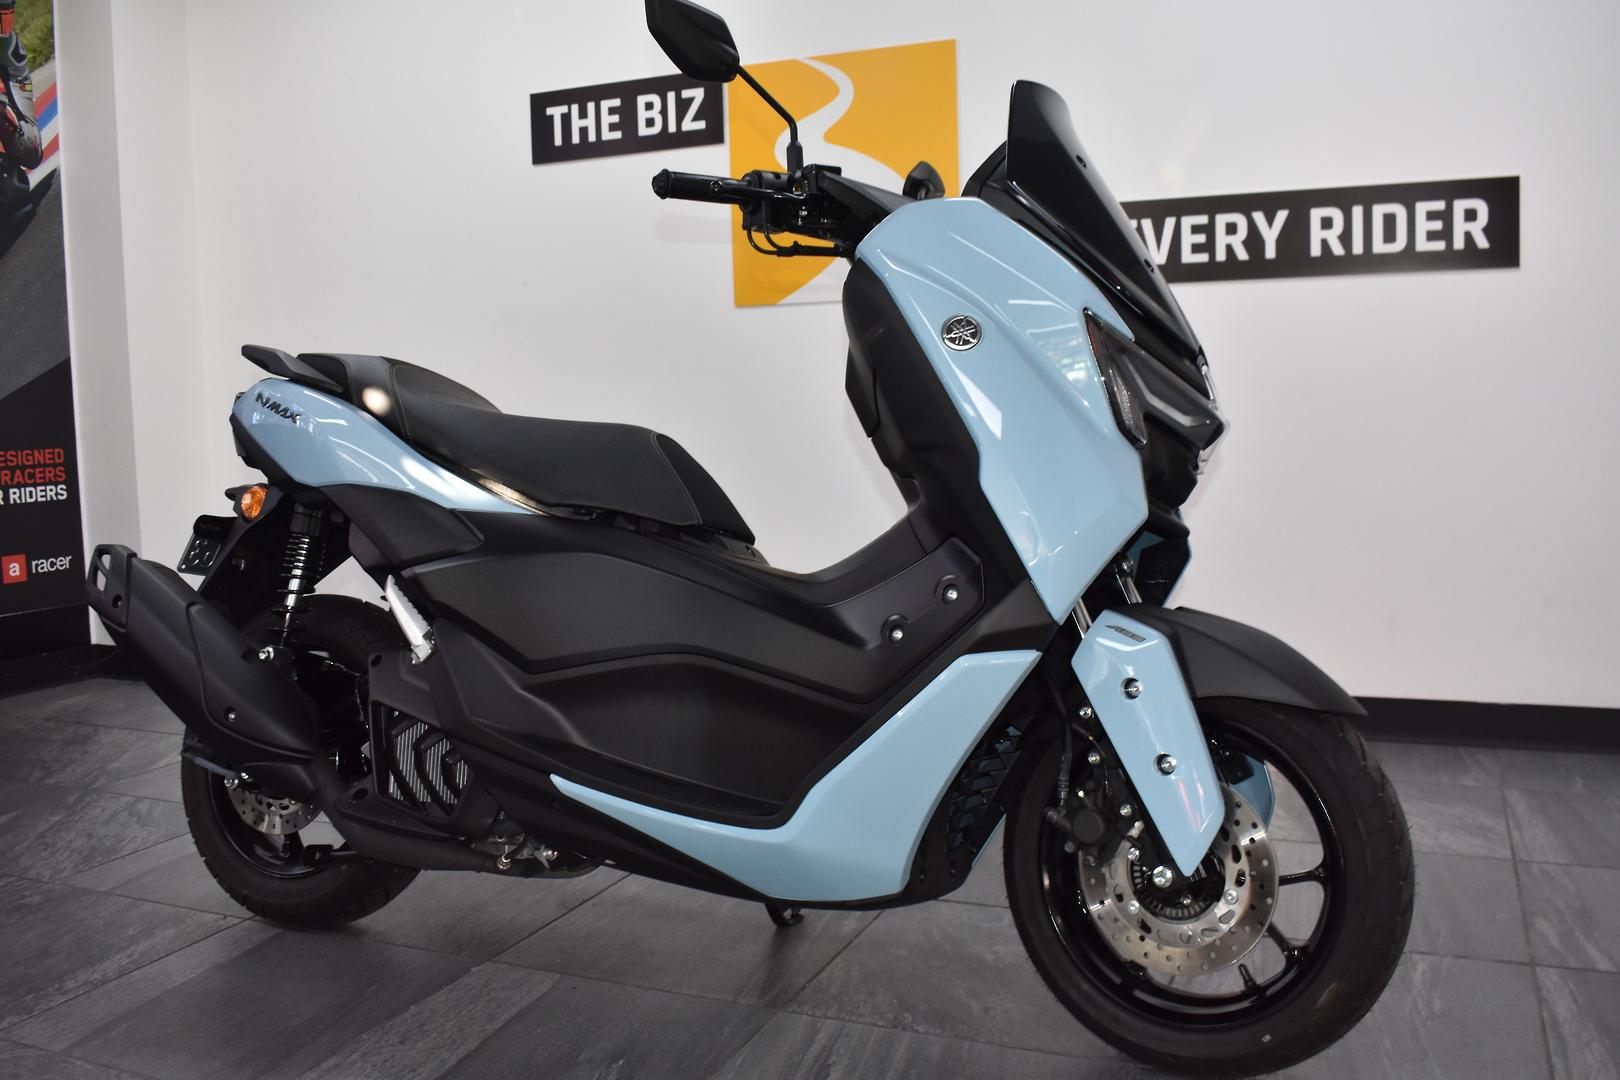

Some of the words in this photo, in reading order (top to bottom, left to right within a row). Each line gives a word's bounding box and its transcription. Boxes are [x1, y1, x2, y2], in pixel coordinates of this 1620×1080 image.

[546, 97, 622, 147] THE
[637, 87, 706, 137] BIZ
[1129, 209, 1290, 266] VERY
[1309, 198, 1490, 258] RIDER
[255, 391, 302, 424] NMAX
[1, 466, 66, 486] RACERS
[9, 484, 68, 505] RIDERS
[31, 555, 72, 574] racer
